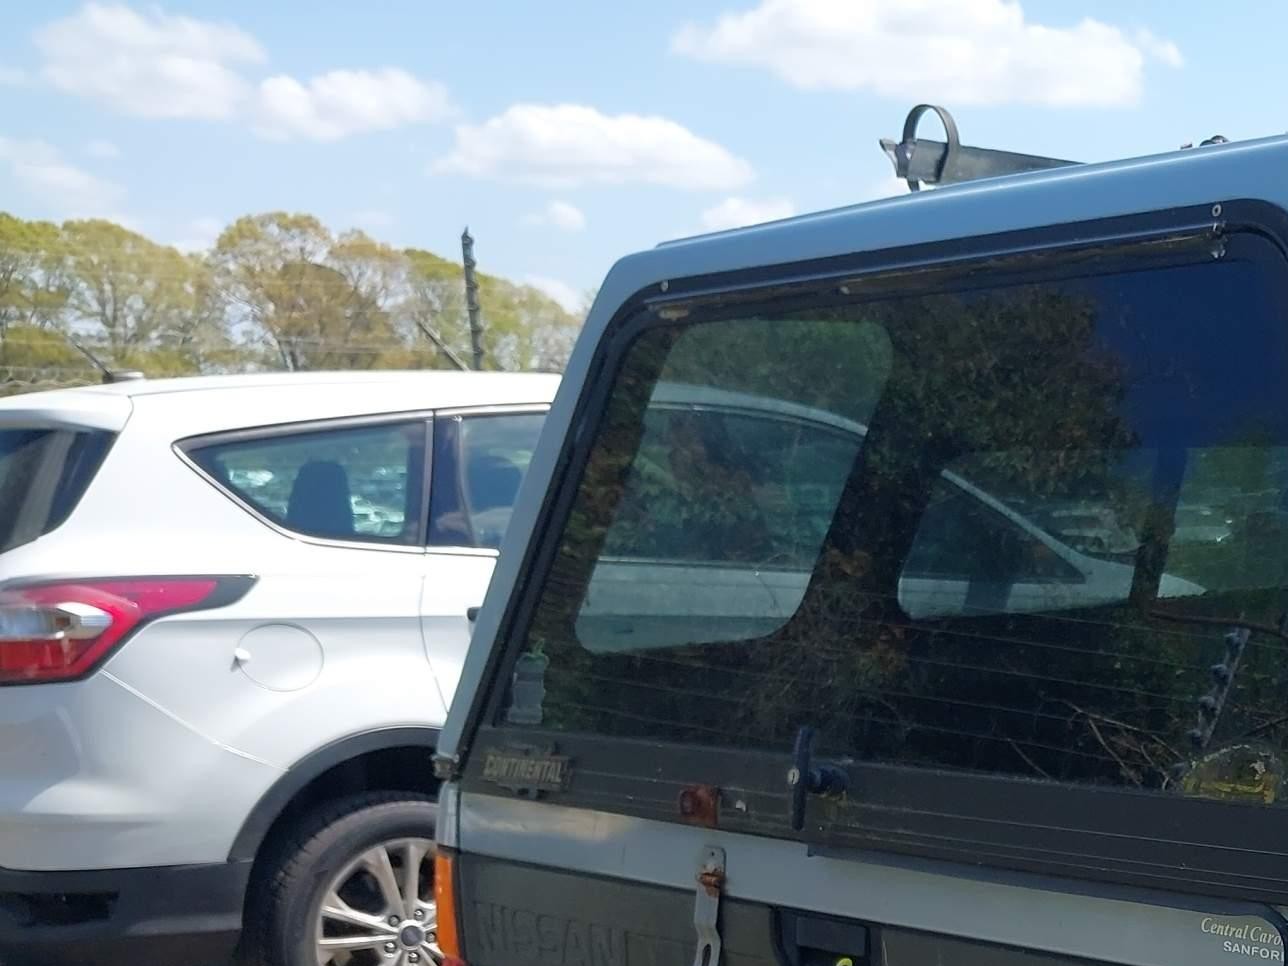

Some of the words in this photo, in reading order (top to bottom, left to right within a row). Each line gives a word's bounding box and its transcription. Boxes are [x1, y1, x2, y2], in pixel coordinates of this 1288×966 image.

[483, 755, 562, 783] CONTINENTAL
[1201, 917, 1249, 940] Central
[1223, 940, 1285, 961] SANFOR
